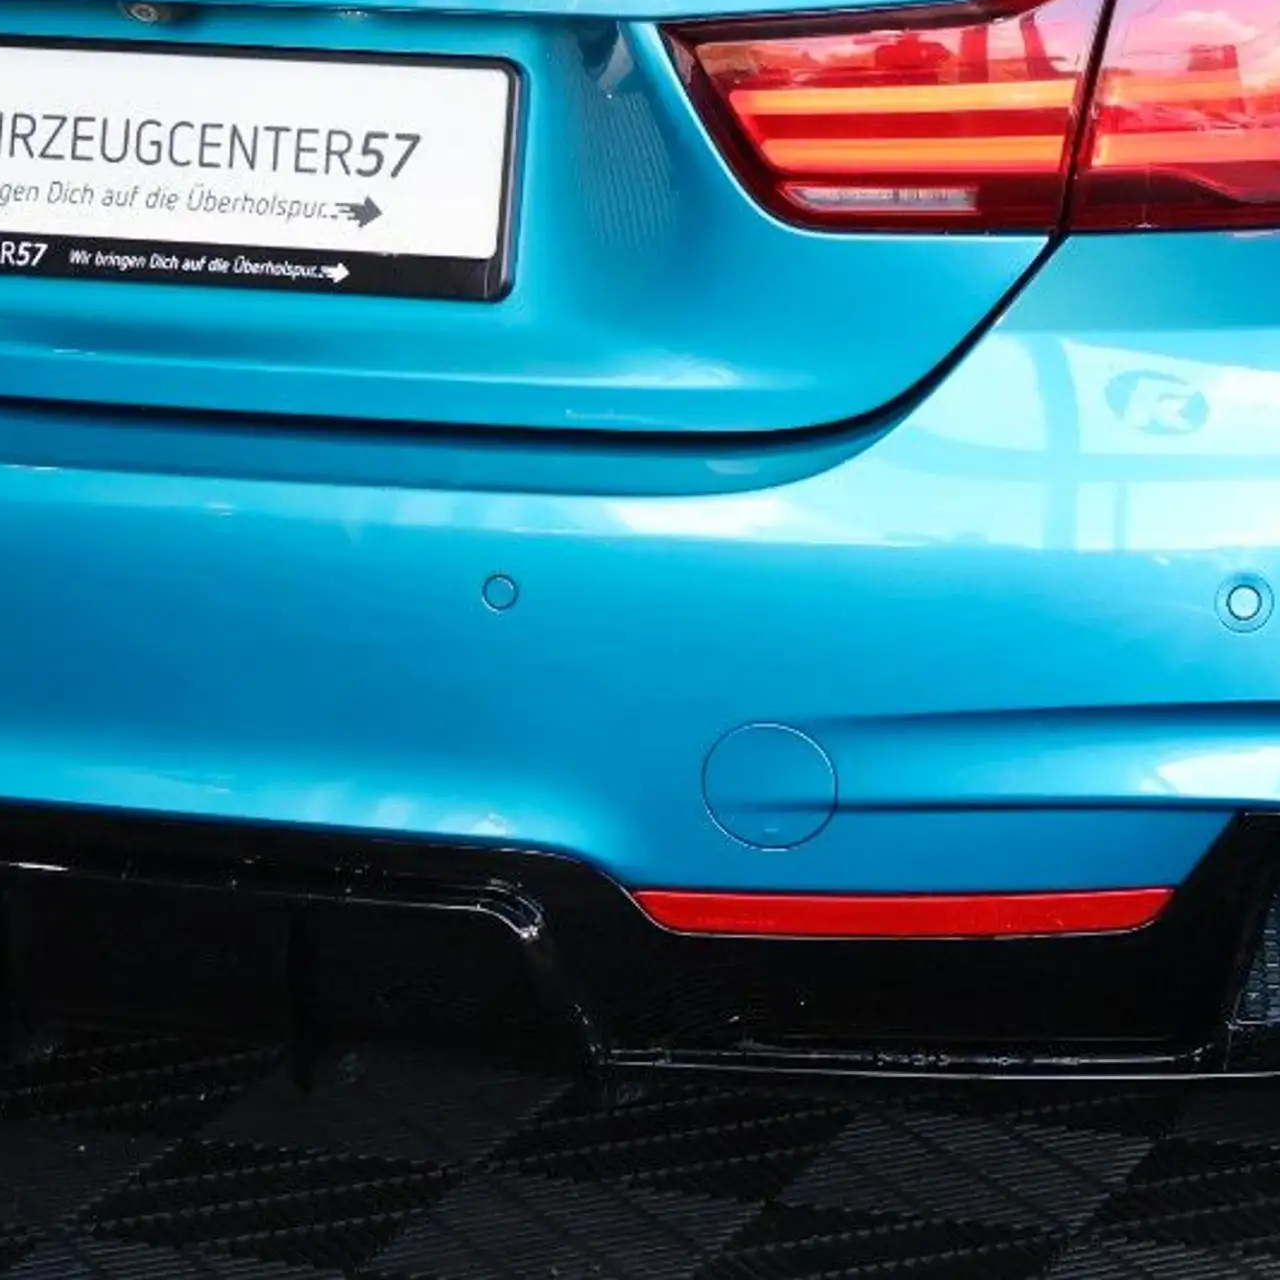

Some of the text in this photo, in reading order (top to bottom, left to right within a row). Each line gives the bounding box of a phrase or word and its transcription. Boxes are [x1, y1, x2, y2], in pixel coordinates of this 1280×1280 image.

[46, 180, 95, 206] Dich
[101, 185, 139, 208] auf
[145, 186, 179, 211] die
[70, 249, 91, 266] Wir
[95, 250, 146, 273] bringen
[150, 252, 179, 270] Dich
[181, 254, 208, 272] auf
[208, 256, 231, 274] die
